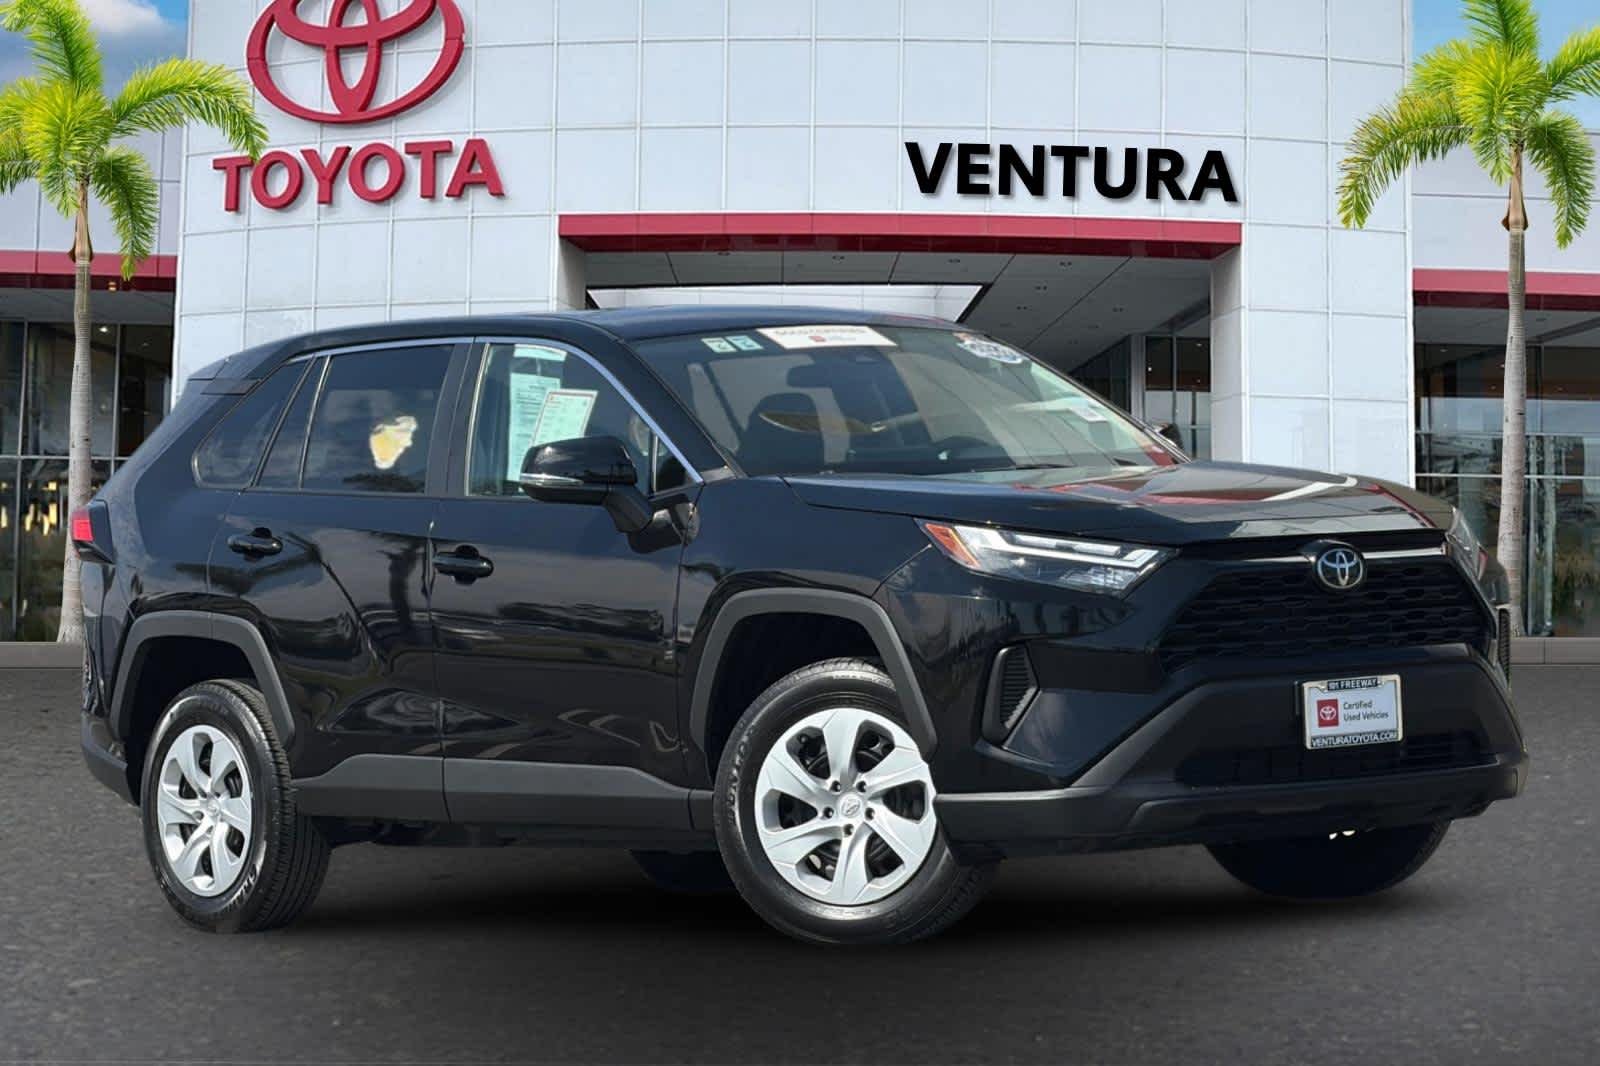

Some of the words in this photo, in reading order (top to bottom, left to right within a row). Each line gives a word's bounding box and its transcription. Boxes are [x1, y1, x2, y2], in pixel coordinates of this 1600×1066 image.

[212, 138, 506, 213] TOYOTA
[905, 142, 1238, 202] VENTURA
[1340, 679, 1377, 689] FREEWAY
[1343, 700, 1373, 710] Certified
[1343, 713, 1361, 721] Used
[1362, 711, 1389, 720] Vehicles
